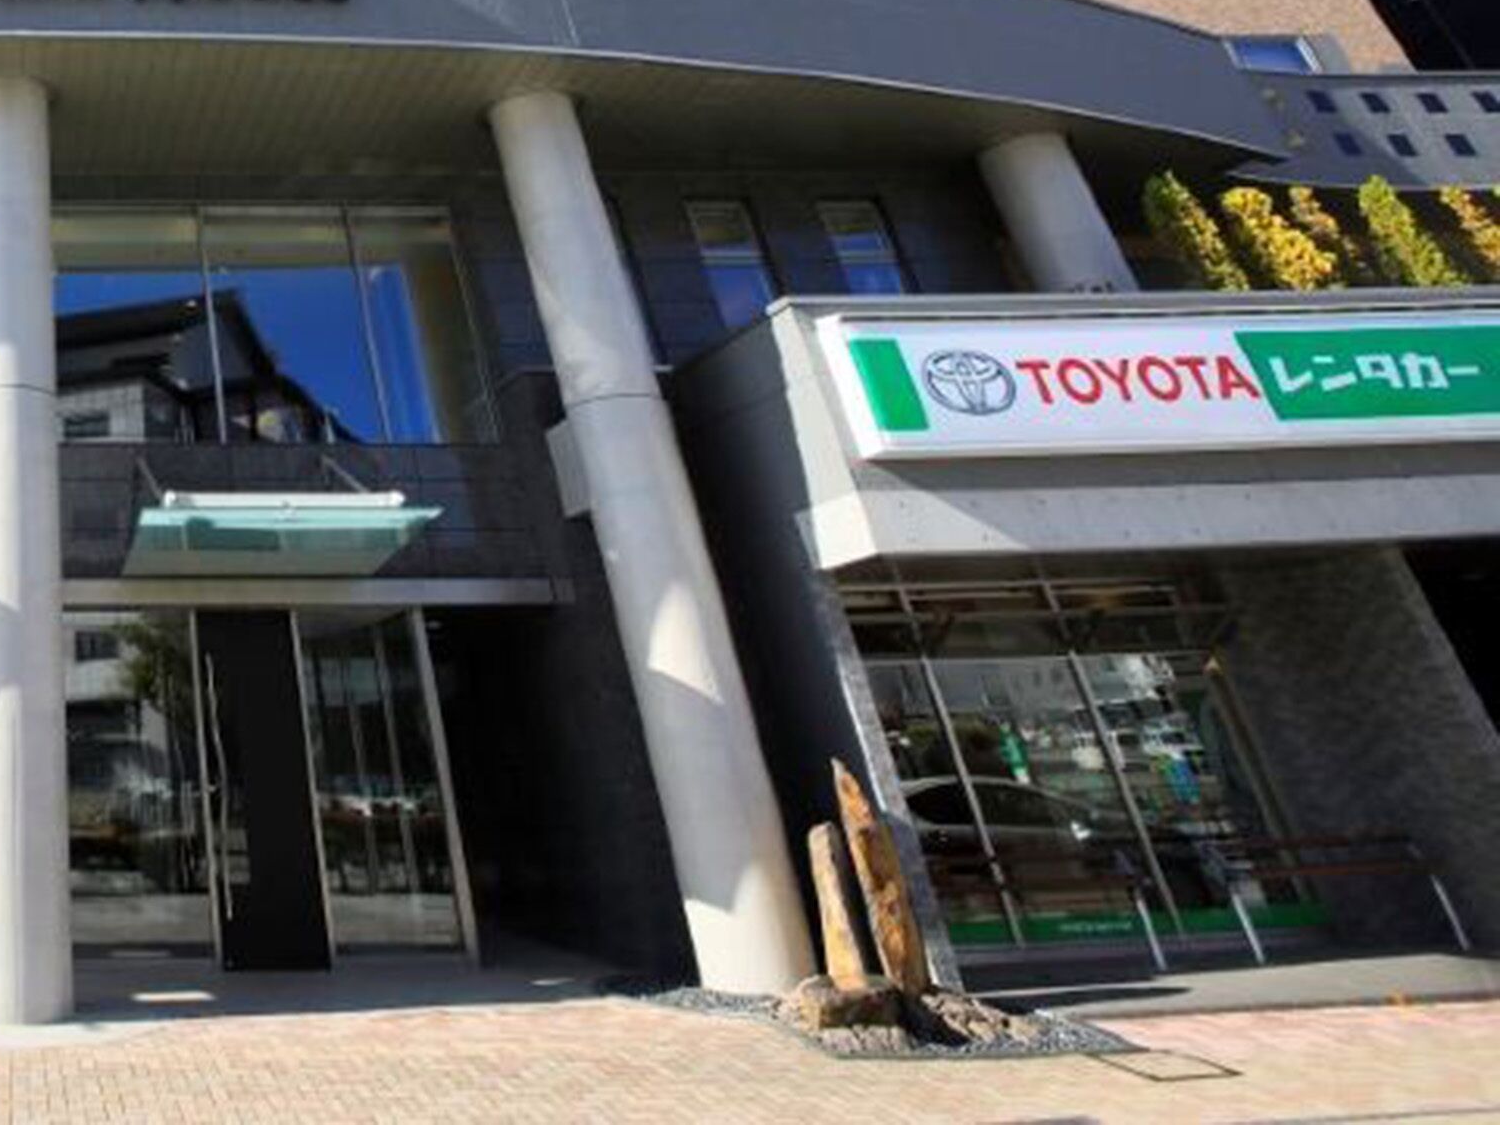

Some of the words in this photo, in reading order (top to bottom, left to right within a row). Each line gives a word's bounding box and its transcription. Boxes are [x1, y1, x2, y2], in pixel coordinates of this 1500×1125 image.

[1016, 355, 1261, 405] TOYOTA
[1269, 351, 1480, 394] レンタカー
